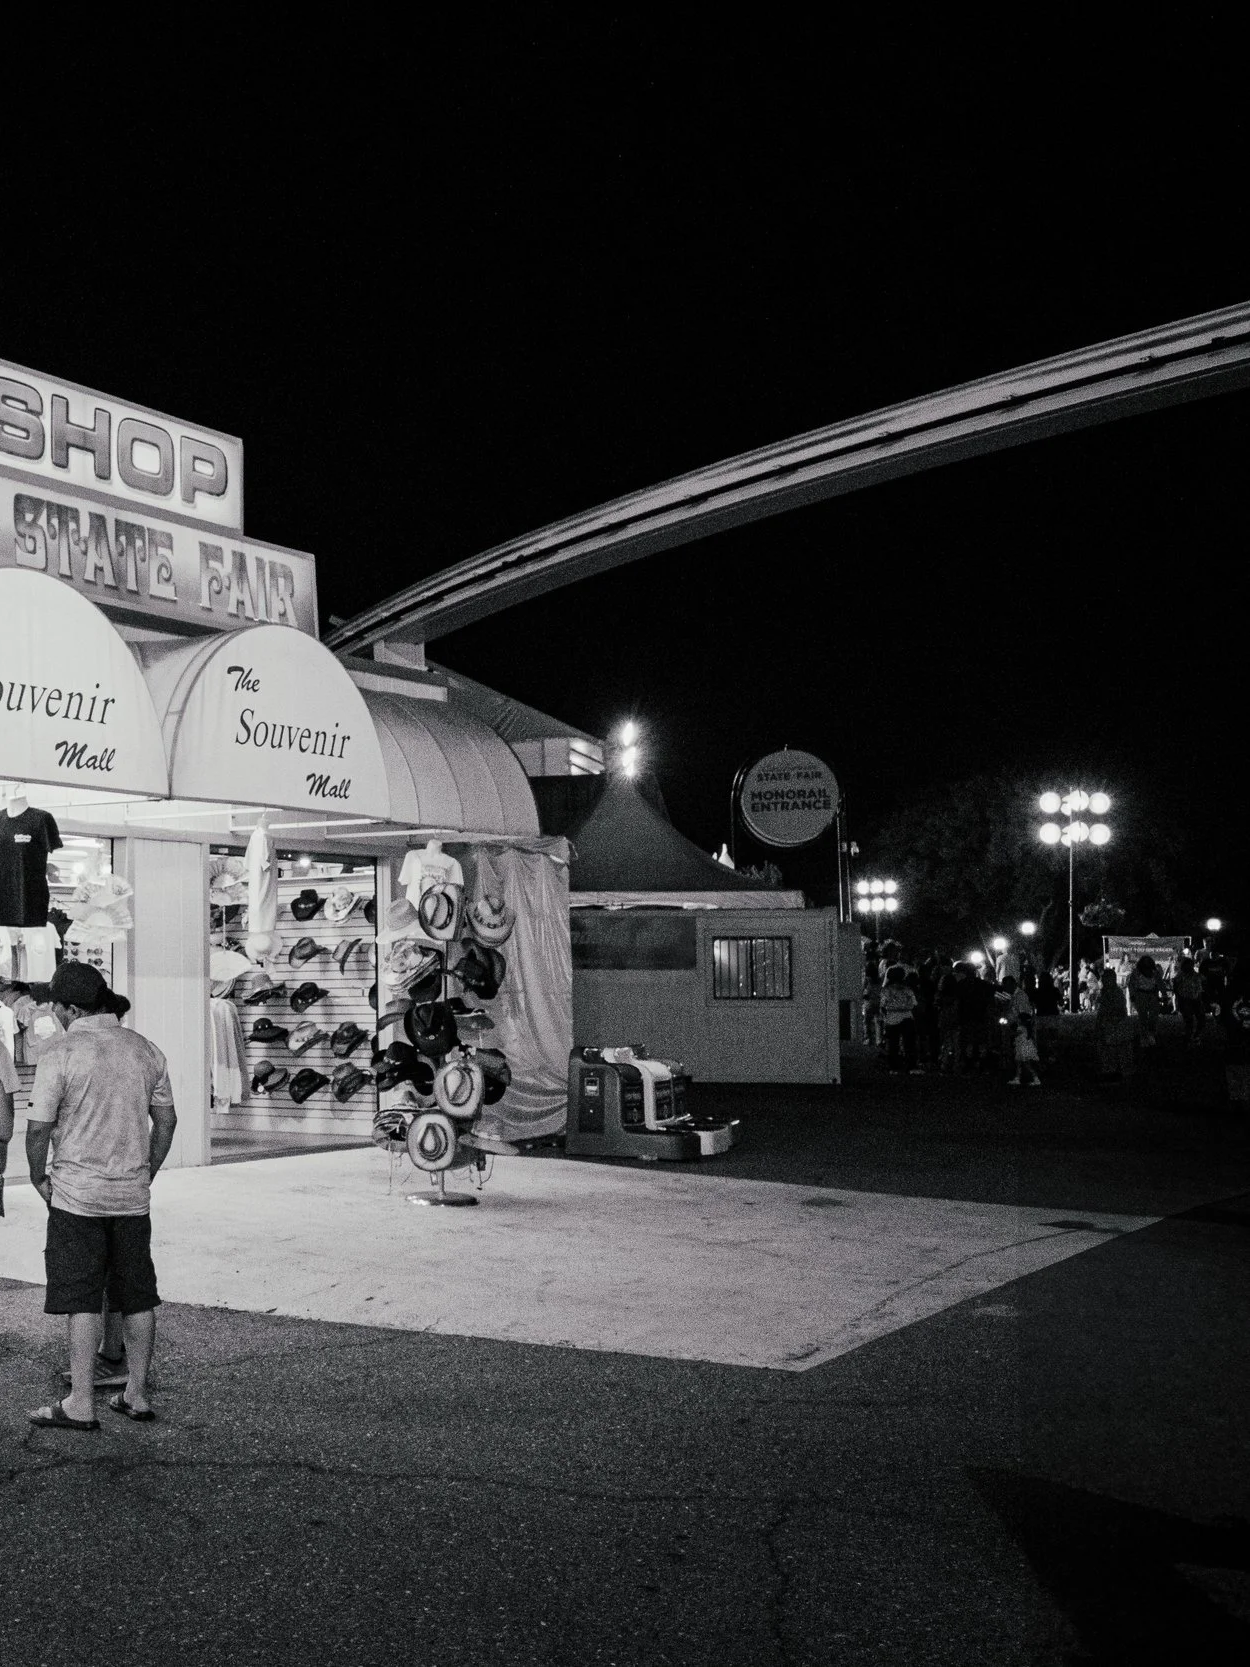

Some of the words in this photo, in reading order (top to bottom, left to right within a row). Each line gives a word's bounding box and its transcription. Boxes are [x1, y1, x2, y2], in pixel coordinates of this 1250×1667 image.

[12, 491, 178, 601] STATE
[196, 540, 297, 627] FAIR
[226, 665, 261, 693] The
[234, 708, 351, 759] Souvenir
[54, 740, 116, 772] Mall
[306, 772, 351, 800] Mall
[757, 772, 790, 782] STATE
[797, 771, 822, 780] FAIR
[751, 788, 830, 801] MONORAIL
[751, 799, 831, 812] ENTRANCE
